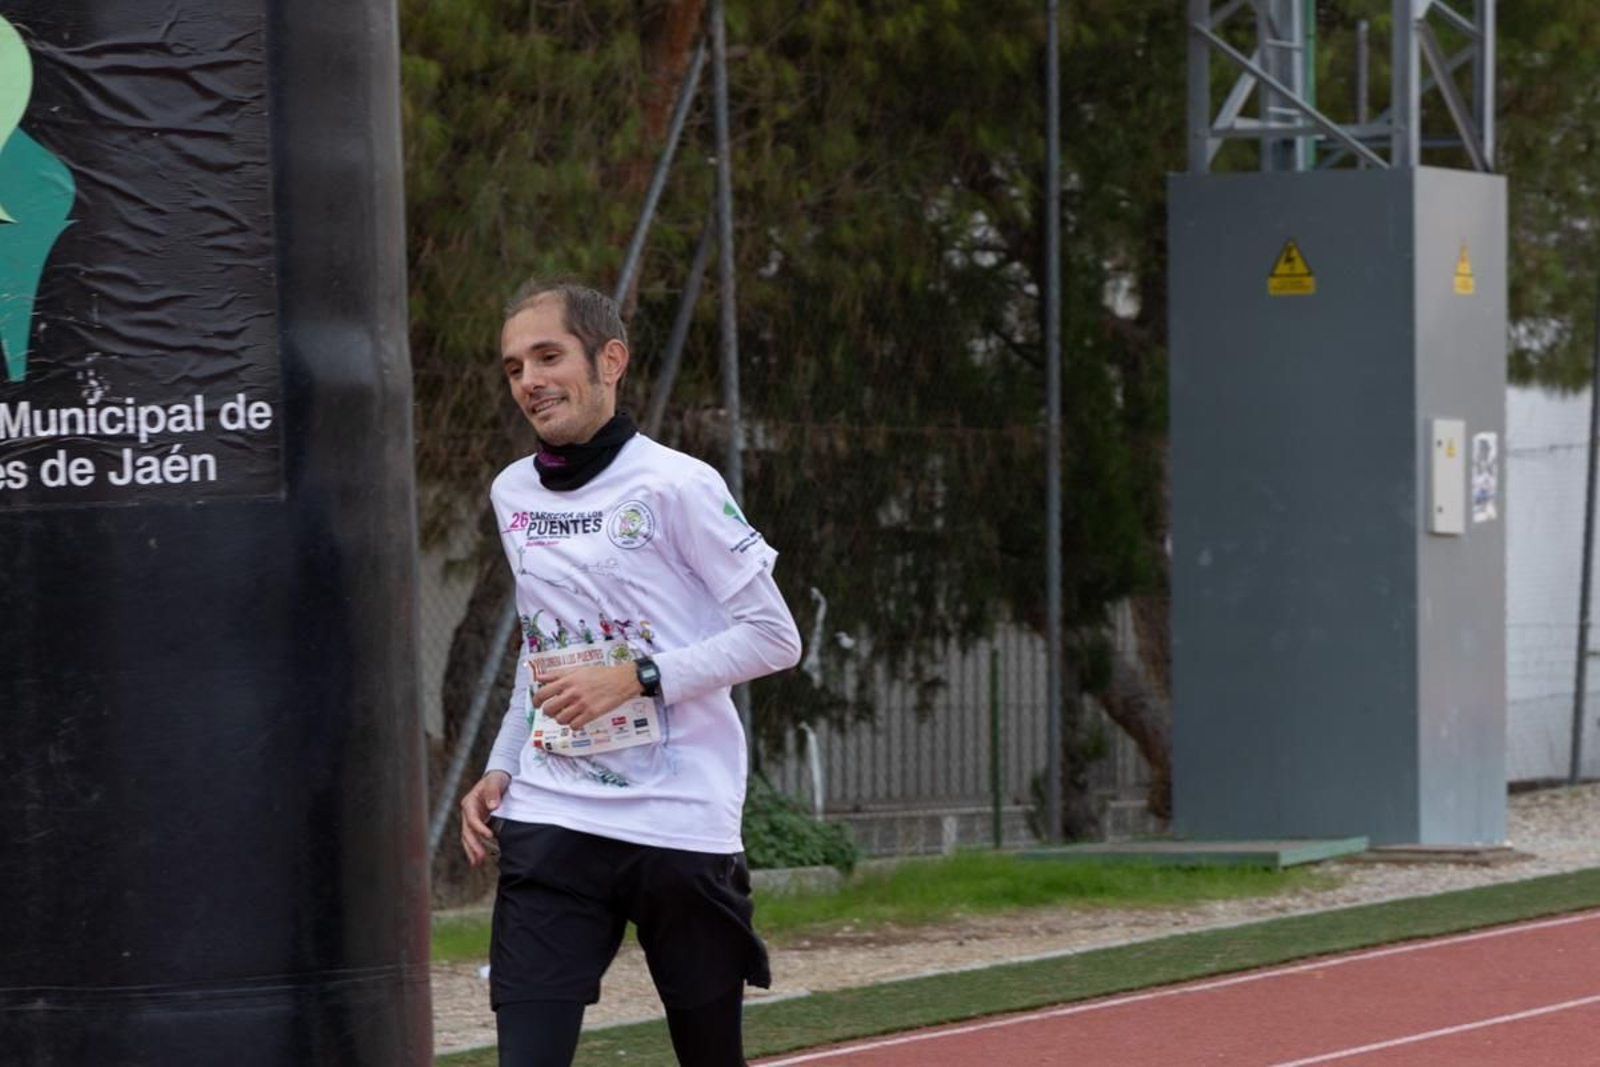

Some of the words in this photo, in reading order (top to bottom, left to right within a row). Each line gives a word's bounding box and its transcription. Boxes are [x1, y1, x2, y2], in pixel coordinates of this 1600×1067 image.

[0, 395, 204, 443] Municipal
[219, 393, 272, 430] de
[40, 449, 95, 488] de
[107, 443, 217, 486] Jaén
[511, 511, 529, 529] 26
[587, 510, 603, 518] LOS
[526, 518, 603, 537] PUENTES
